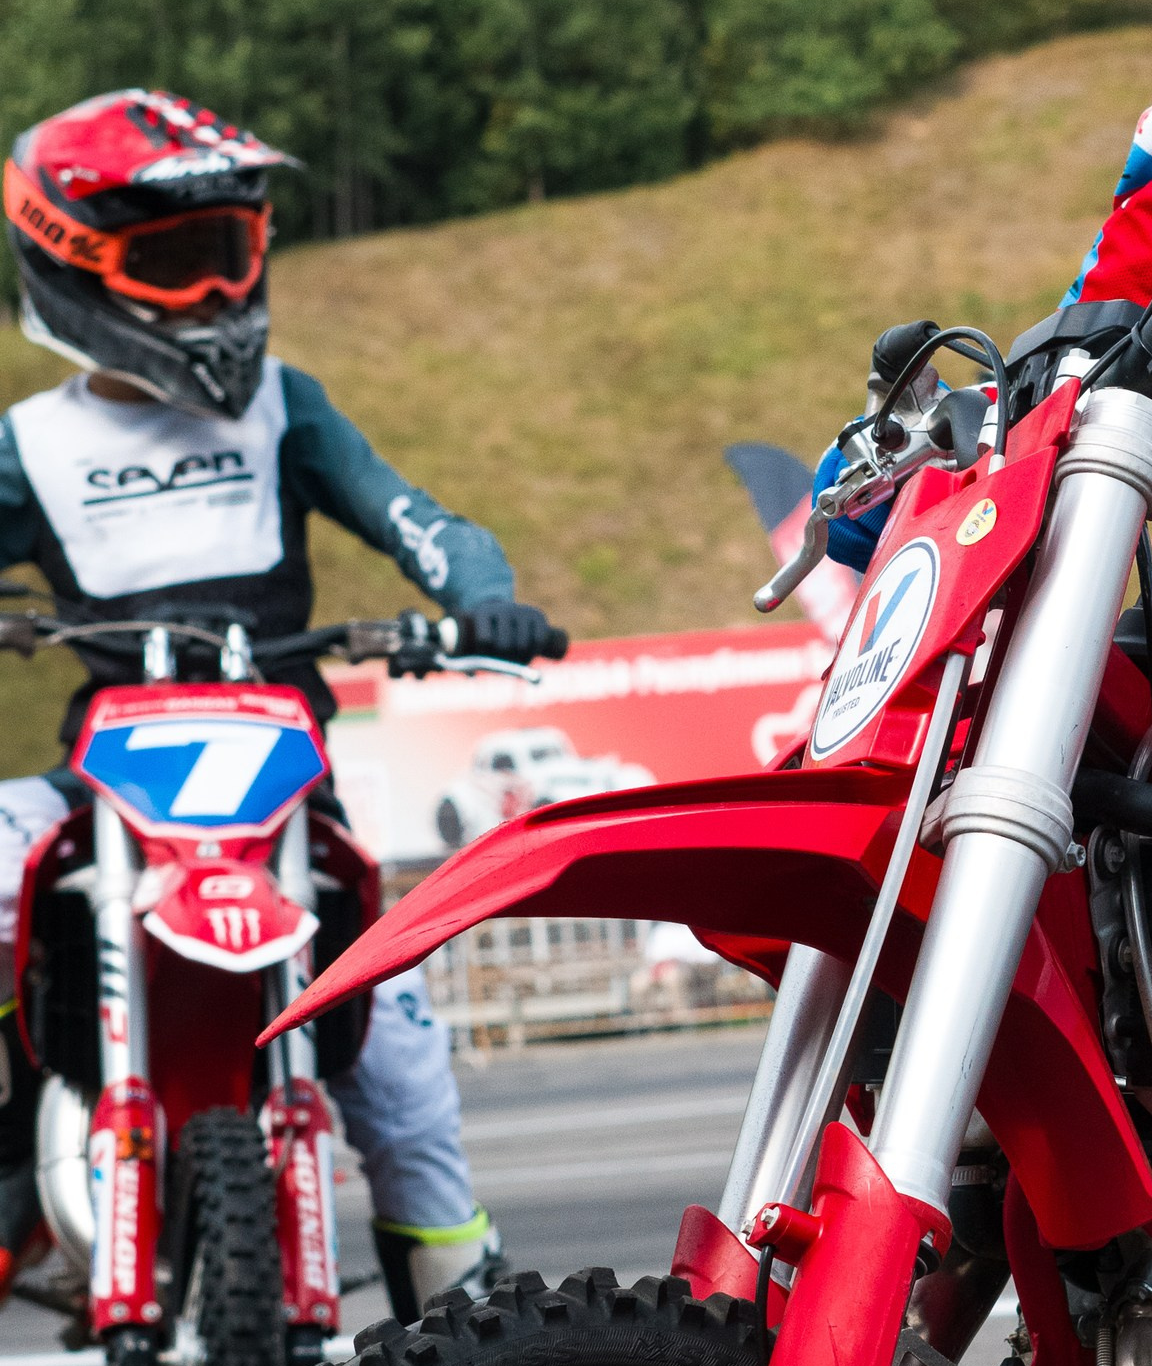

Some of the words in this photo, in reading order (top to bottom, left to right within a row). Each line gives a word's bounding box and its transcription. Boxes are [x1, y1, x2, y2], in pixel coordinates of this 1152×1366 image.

[18, 198, 104, 263] 100%
[821, 637, 902, 720] VALVOLINE
[125, 721, 282, 817] 7
